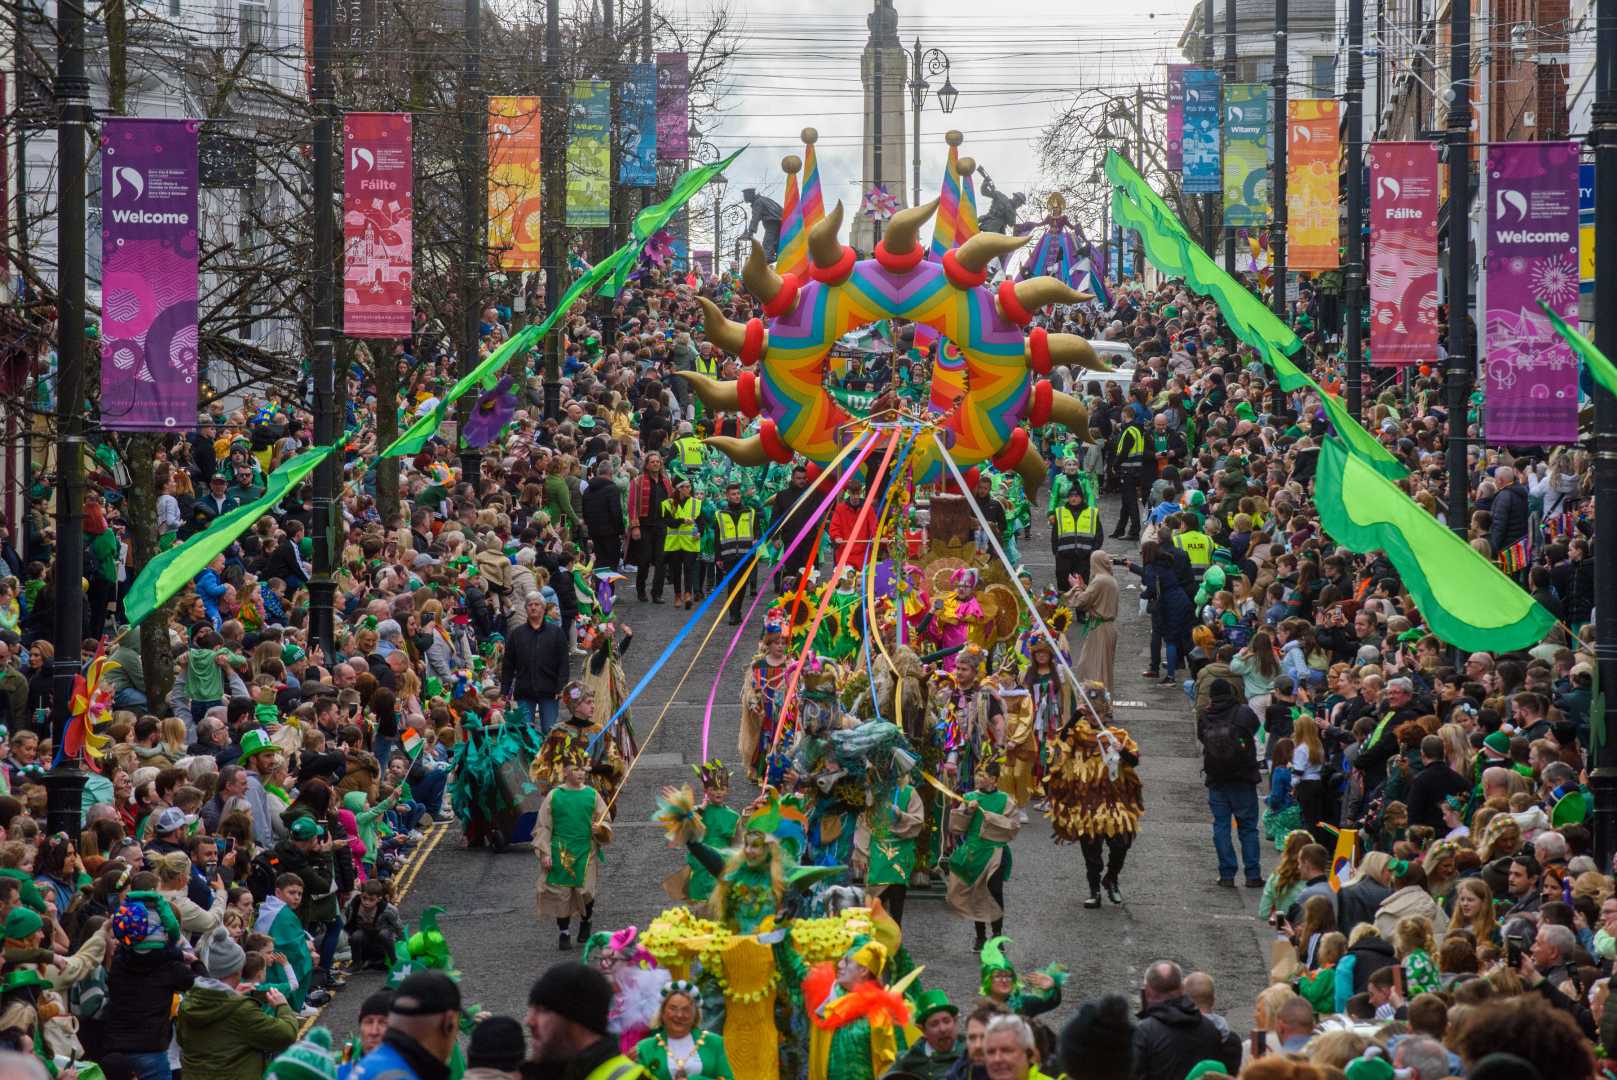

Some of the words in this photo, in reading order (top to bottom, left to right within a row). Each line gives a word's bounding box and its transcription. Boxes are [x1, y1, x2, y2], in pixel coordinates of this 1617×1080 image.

[361, 179, 397, 190] Fáilte
[112, 210, 189, 224] Welcome
[1385, 207, 1423, 219] Fáilte
[1496, 230, 1570, 243] Welcome
